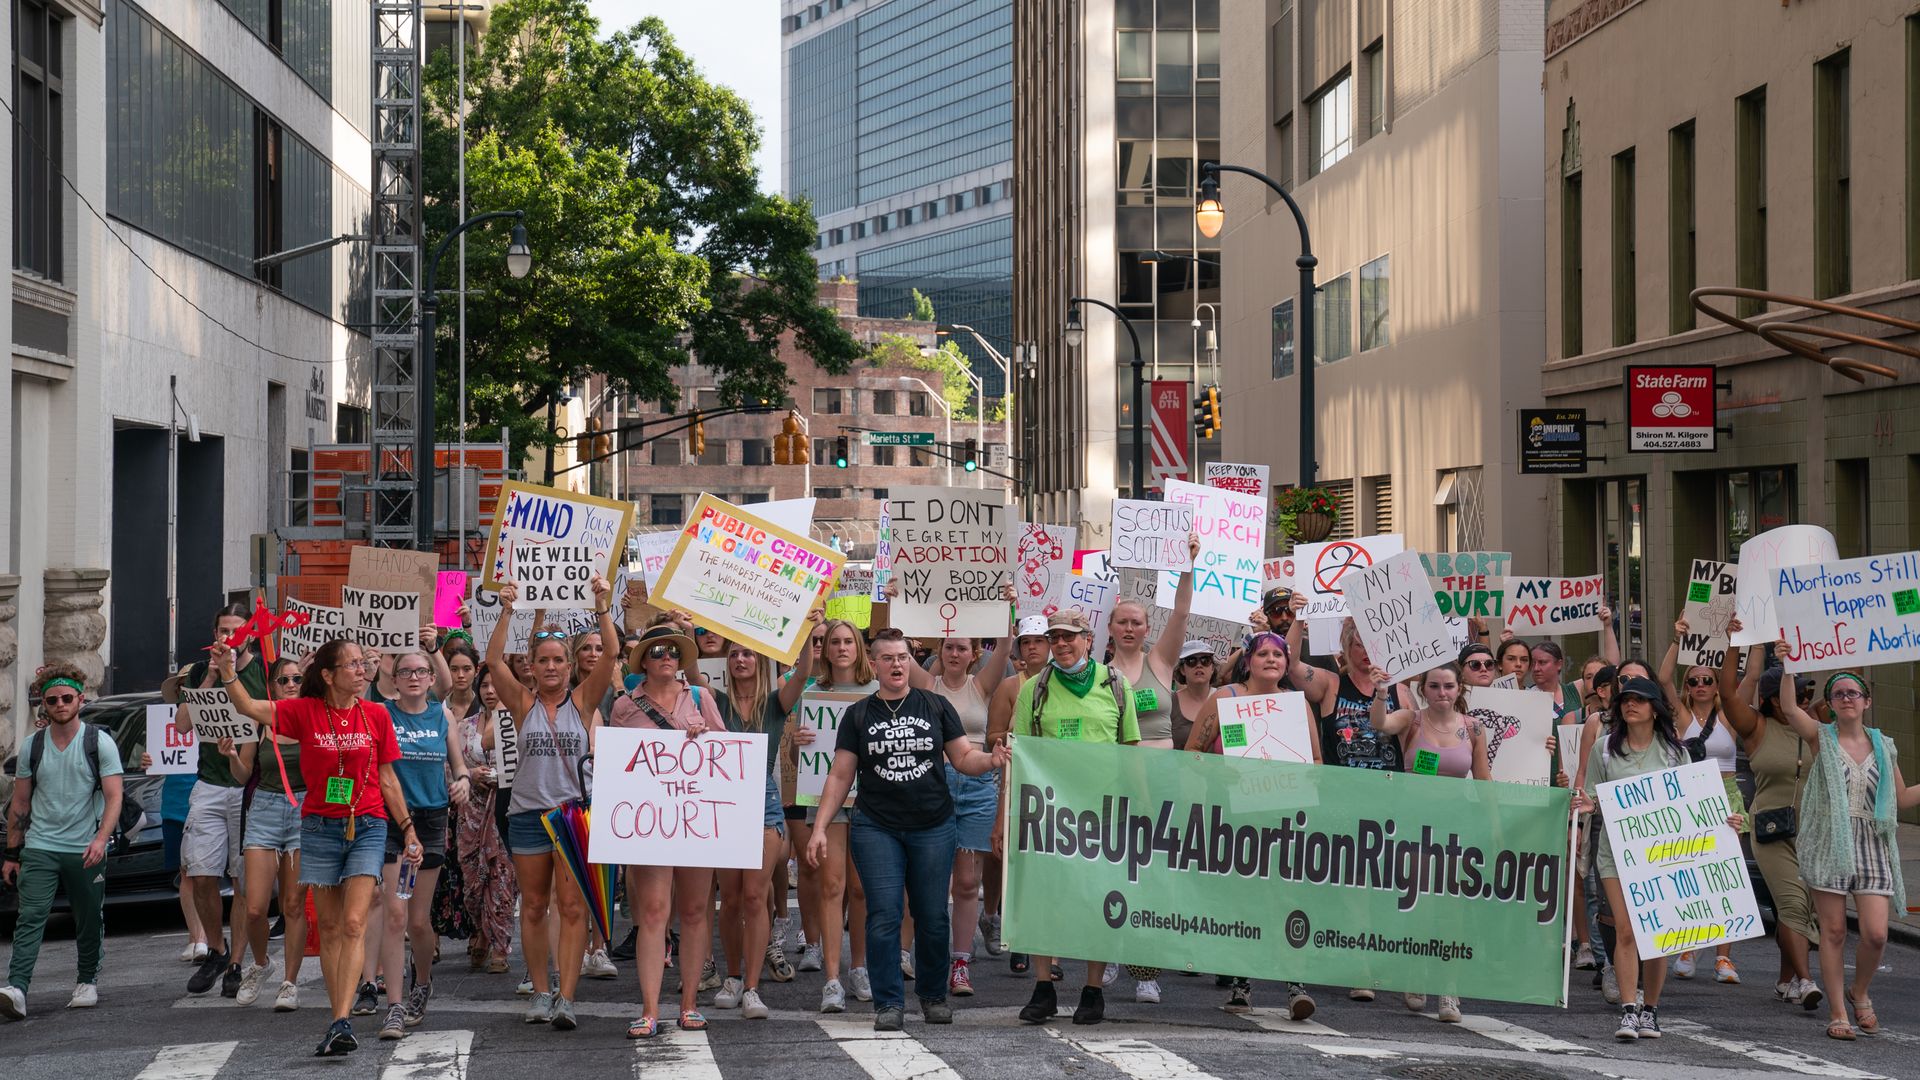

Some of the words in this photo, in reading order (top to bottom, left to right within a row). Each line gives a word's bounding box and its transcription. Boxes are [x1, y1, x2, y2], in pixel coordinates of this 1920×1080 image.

[1159, 400, 1180, 409] DTN
[1160, 390, 1179, 400] ATL
[869, 434, 900, 444] Marietta
[902, 434, 911, 444] St
[1543, 424, 1575, 433] IMPRINT
[1636, 431, 1663, 439] Shiron
[1677, 431, 1709, 440] Kilgore
[1873, 409, 1894, 447] 44
[1208, 465, 1232, 476] KEEP
[1234, 465, 1257, 476] YOUR
[511, 495, 573, 539] MIND
[585, 506, 614, 535] YOUR
[892, 500, 915, 521] I
[927, 499, 1003, 526] DONT
[1116, 506, 1191, 533] SCOTUS
[1224, 497, 1263, 523] YOUR
[1732, 510, 1748, 535] Life
[580, 532, 613, 549] OWN
[701, 505, 766, 545] PUBLIC
[771, 538, 838, 578] CERVIX
[892, 528, 968, 543] REGRET
[981, 531, 1003, 545] MY
[516, 547, 541, 562] WE
[547, 547, 592, 562] WILL
[684, 523, 831, 596] ANNOUNCEMENT
[894, 546, 1007, 564] ABORTION
[1117, 535, 1186, 565] SCOTASS
[367, 551, 420, 574] HANDS
[1204, 550, 1228, 566] OF
[1236, 557, 1259, 573] MY
[1418, 553, 1512, 577] ABORT
[1693, 560, 1726, 582] MY
[446, 573, 462, 586] GO
[517, 565, 556, 581] NOT
[564, 566, 590, 581] GO
[700, 550, 722, 566] THE
[722, 560, 762, 583] HARDEST
[763, 577, 800, 603] DECISION
[843, 569, 856, 579] NOT
[903, 569, 931, 586] MY
[949, 570, 1004, 586] BODY
[1363, 564, 1391, 600] MY
[1443, 575, 1486, 590] THE
[1778, 564, 1862, 596] Abortions
[1870, 555, 1918, 583] Still
[343, 588, 366, 607] MY
[370, 593, 419, 610] BODY
[526, 585, 586, 601] BACK
[695, 582, 737, 607] ISN'T
[704, 569, 711, 578] A
[718, 573, 755, 596] WOMAN
[757, 589, 783, 608] MAKES
[904, 588, 932, 604] MY
[945, 586, 1006, 601] CHOICE
[1070, 581, 1108, 604] GET
[1516, 580, 1552, 599] MY
[1560, 578, 1603, 599] BODY
[1365, 591, 1412, 632] BODY
[1434, 590, 1504, 617] OURT
[1507, 604, 1547, 626] MY
[1550, 601, 1599, 623] CHOICE
[1737, 594, 1772, 630] MY
[1822, 591, 1886, 619] Happen
[359, 610, 385, 628] MY
[475, 609, 500, 622] Hav
[346, 627, 414, 648] CHOICE
[1385, 622, 1410, 653] MY
[1681, 634, 1710, 651] MY
[1780, 622, 1856, 662] Unsafe
[1386, 639, 1446, 676] CHOICE
[183, 691, 216, 705] BANS
[1236, 698, 1282, 719] HER
[200, 709, 232, 722] OUR
[804, 706, 842, 730] MY
[868, 721, 891, 735] OUR
[890, 716, 932, 731] BODIES
[196, 723, 253, 738] BODIES
[314, 732, 335, 740] MAKE
[337, 732, 371, 741] AMERICA
[526, 731, 543, 739] THIS
[885, 728, 916, 740] OUR
[526, 739, 581, 749] FEMIIST
[868, 737, 934, 755] FUTURES
[161, 750, 187, 765] WE
[624, 738, 753, 782] ABORT
[799, 751, 835, 775] MY
[887, 755, 917, 769] OUR
[874, 759, 934, 781] ABORTIONS
[660, 780, 702, 797] THE
[1240, 772, 1298, 796] CHOICE
[1663, 770, 1686, 801] BE
[610, 800, 736, 840] COURT
[1614, 806, 1682, 842] TRUSTED
[1687, 796, 1729, 827] WITH
[1019, 784, 1560, 925] RiseUp4AbortionRights.org
[1624, 848, 1636, 867] A
[1628, 875, 1665, 907] BUT
[1667, 867, 1700, 900] YOU
[1699, 856, 1746, 894] TRUST
[1130, 910, 1261, 940] @RiseUp4Abortion
[1637, 909, 1663, 933] ME
[1675, 899, 1713, 922] WITH
[1722, 897, 1733, 916] A
[1313, 929, 1473, 962] @Rise4AbortionRights
